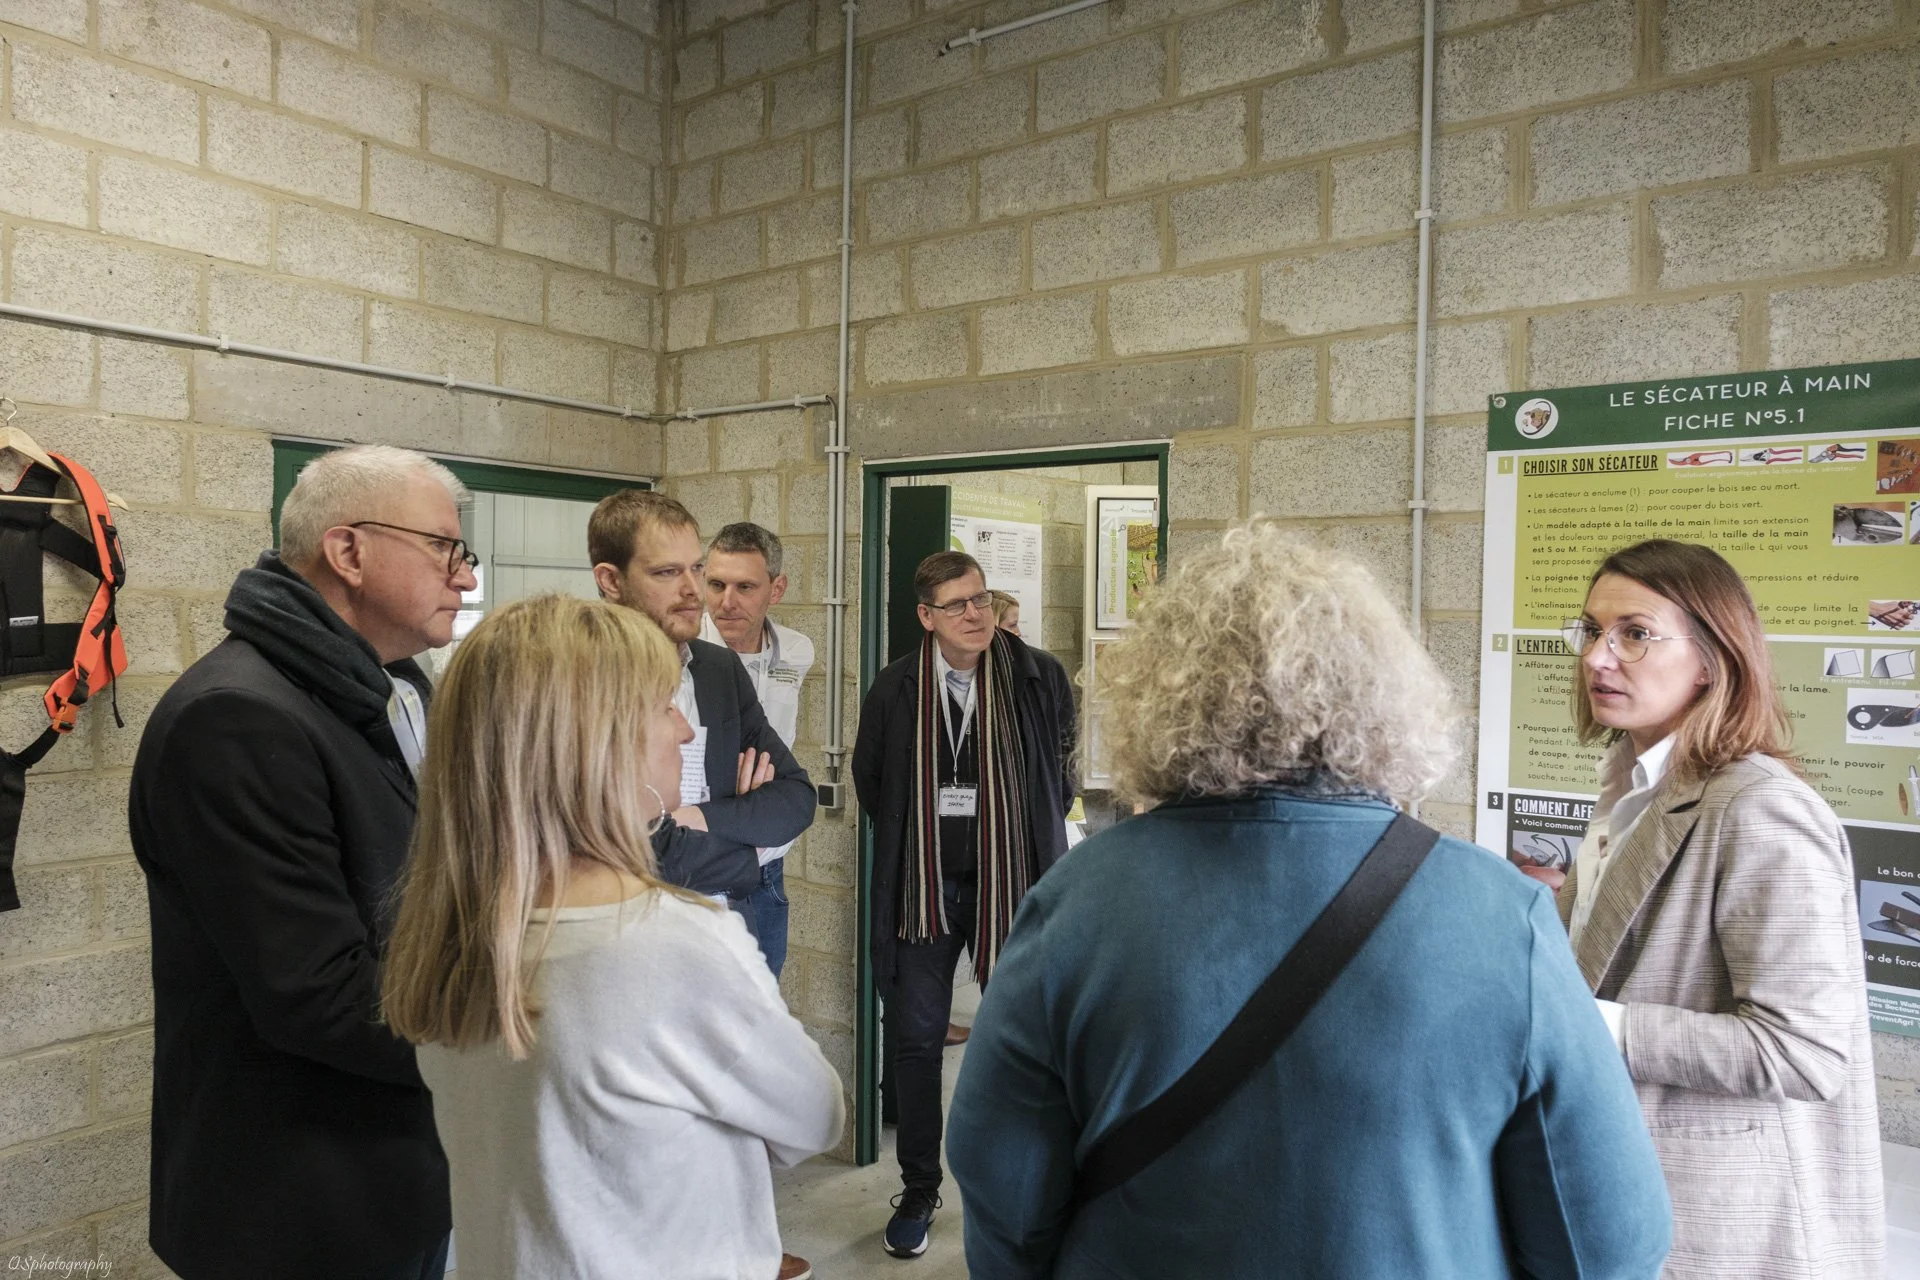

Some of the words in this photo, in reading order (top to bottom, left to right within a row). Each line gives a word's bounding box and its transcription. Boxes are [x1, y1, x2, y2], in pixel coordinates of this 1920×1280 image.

[1609, 391, 1635, 408] LE
[1643, 381, 1768, 406] SÉCATEUR
[1777, 375, 1794, 395] À
[1805, 373, 1871, 393] MAIN
[1664, 412, 1735, 432] FICHE
[1745, 407, 1805, 427] N°5.1
[1523, 459, 1568, 475] CHOISIR
[1571, 457, 1595, 473] SON
[1598, 453, 1659, 471] SÉCATEUR
[1533, 491, 1543, 499] Le
[1545, 490, 1581, 499] sécateur
[1583, 489, 1590, 497] à
[1591, 487, 1628, 497] enclume
[1629, 487, 1641, 497] (1)
[1648, 487, 1669, 497] pour
[1671, 486, 1704, 496] couper
[1706, 484, 1716, 493] le
[1718, 484, 1738, 493] bois
[1760, 484, 1773, 492] ou
[1774, 482, 1801, 491] mort.
[1533, 506, 1547, 515] Les
[1548, 505, 1588, 514] sécateurs
[1590, 504, 1596, 513] à
[1598, 503, 1624, 513] lames
[1625, 503, 1639, 513] (2)
[1646, 503, 1667, 513] pour
[1669, 502, 1702, 512] couper
[1704, 501, 1716, 510] du
[1719, 500, 1739, 510] bois
[1741, 501, 1764, 509] vert.
[1546, 521, 1577, 530] modèle
[1579, 520, 1611, 530] adapté
[1614, 519, 1621, 528] à
[1622, 519, 1632, 528] la
[1634, 518, 1658, 528] taille
[1660, 518, 1673, 527] de
[1675, 518, 1685, 527] la
[1687, 518, 1711, 527] main
[1713, 517, 1740, 526] limite
[1743, 518, 1759, 526] son
[1762, 517, 1809, 526] extension
[1532, 534, 1541, 542] et
[1544, 533, 1556, 541] les
[1559, 533, 1594, 542] douleurs
[1611, 533, 1648, 543] poignet.
[1708, 530, 1718, 539] la
[1722, 530, 1748, 539] taille
[1752, 530, 1765, 538] de
[1769, 530, 1779, 538] la
[1784, 529, 1809, 538] main
[1532, 545, 1545, 554] est
[1547, 545, 1553, 554] S
[1555, 546, 1566, 554] ou
[1581, 545, 1607, 554] Faites
[1718, 543, 1728, 551] la
[1731, 543, 1756, 551] taille
[1759, 543, 1764, 551] L
[1767, 543, 1783, 553] qui
[1786, 543, 1809, 551] vous
[1552, 558, 1592, 567] proposée
[1544, 574, 1579, 583] poignée
[1742, 573, 1803, 583] ompressions
[1806, 573, 1818, 582] et
[1822, 573, 1860, 582] réduire
[1531, 585, 1542, 593] les
[1544, 585, 1580, 594] frictions.
[1530, 601, 1582, 609] L'inclinaison
[1757, 603, 1770, 612] de
[1775, 604, 1807, 614] coupe
[1813, 603, 1842, 613] limite
[1848, 603, 1858, 613] la
[1530, 613, 1558, 621] flexion
[1785, 617, 1795, 625] et
[1798, 618, 1811, 626] au
[1813, 617, 1857, 628] poignet.
[1497, 636, 1503, 648] 2
[1516, 639, 1572, 654] L'ENTRET
[1524, 661, 1553, 669] Affûter
[1537, 673, 1575, 683] L'affutag
[1537, 686, 1573, 695] L'affilag
[1789, 683, 1800, 693] la
[1802, 684, 1831, 694] lame.
[1522, 723, 1560, 734] Pourquoi
[1528, 736, 1563, 746] Pendant
[1528, 748, 1540, 757] de
[1541, 750, 1570, 760] coupe,
[1574, 752, 1597, 761] évite
[1537, 760, 1565, 770] Astuce
[1830, 757, 1840, 767] le
[1844, 760, 1886, 769] pouvoir
[1527, 773, 1558, 782] souche,
[1588, 777, 1598, 785] et
[1821, 783, 1843, 794] bois
[1846, 785, 1884, 798] (coupe
[1492, 795, 1499, 806] 3
[1514, 798, 1570, 817] COMMENT
[1521, 818, 1543, 828] Voici
[1544, 821, 1583, 832] comment
[1877, 866, 1890, 876] Le
[1893, 867, 1914, 879] bon
[1877, 952, 1892, 964] de
